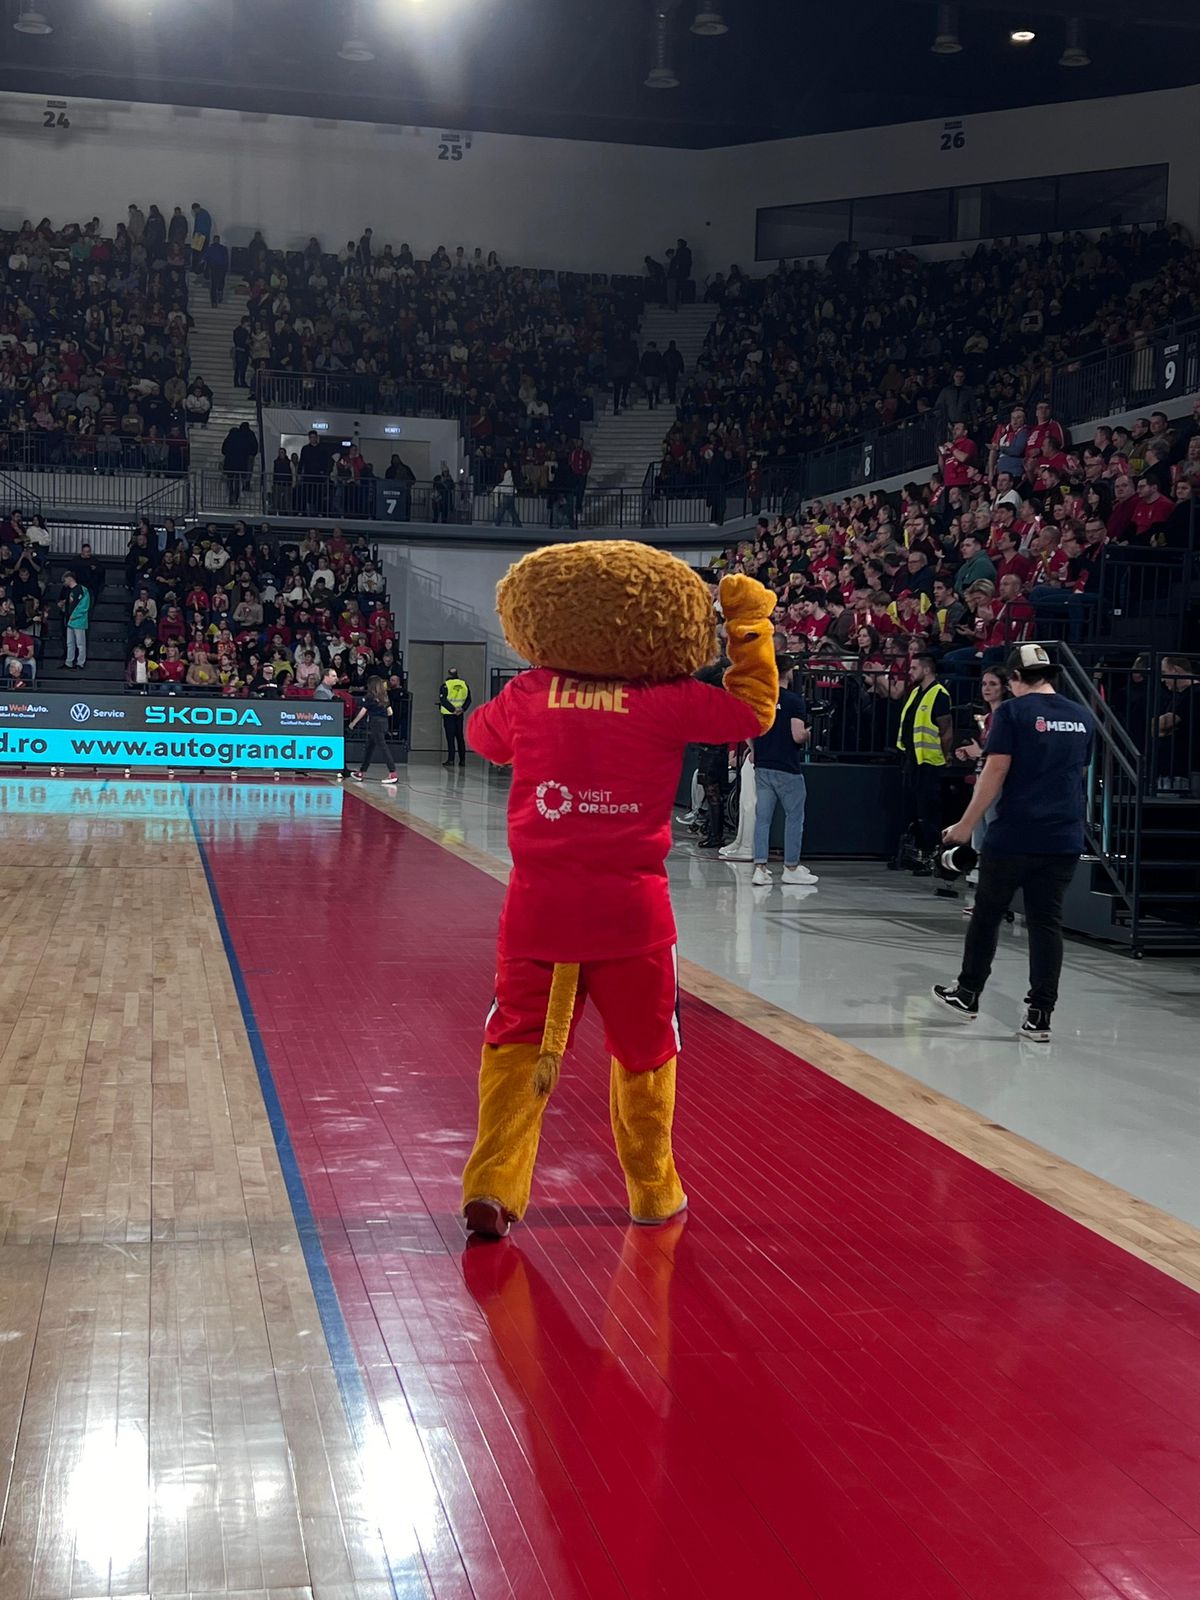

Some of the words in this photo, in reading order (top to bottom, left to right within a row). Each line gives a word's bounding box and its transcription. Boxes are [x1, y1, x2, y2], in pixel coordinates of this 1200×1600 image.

[43, 111, 70, 128] 24
[941, 131, 965, 150] 26
[438, 144, 463, 161] 25
[1165, 361, 1176, 389] 9
[864, 457, 871, 477] 8
[386, 499, 397, 514] 7
[547, 676, 629, 714] LEONE
[93, 708, 125, 718] Service
[280, 711, 296, 720] Das
[1047, 720, 1087, 733] MEDIA
[71, 737, 334, 764] www.autogrand.ro
